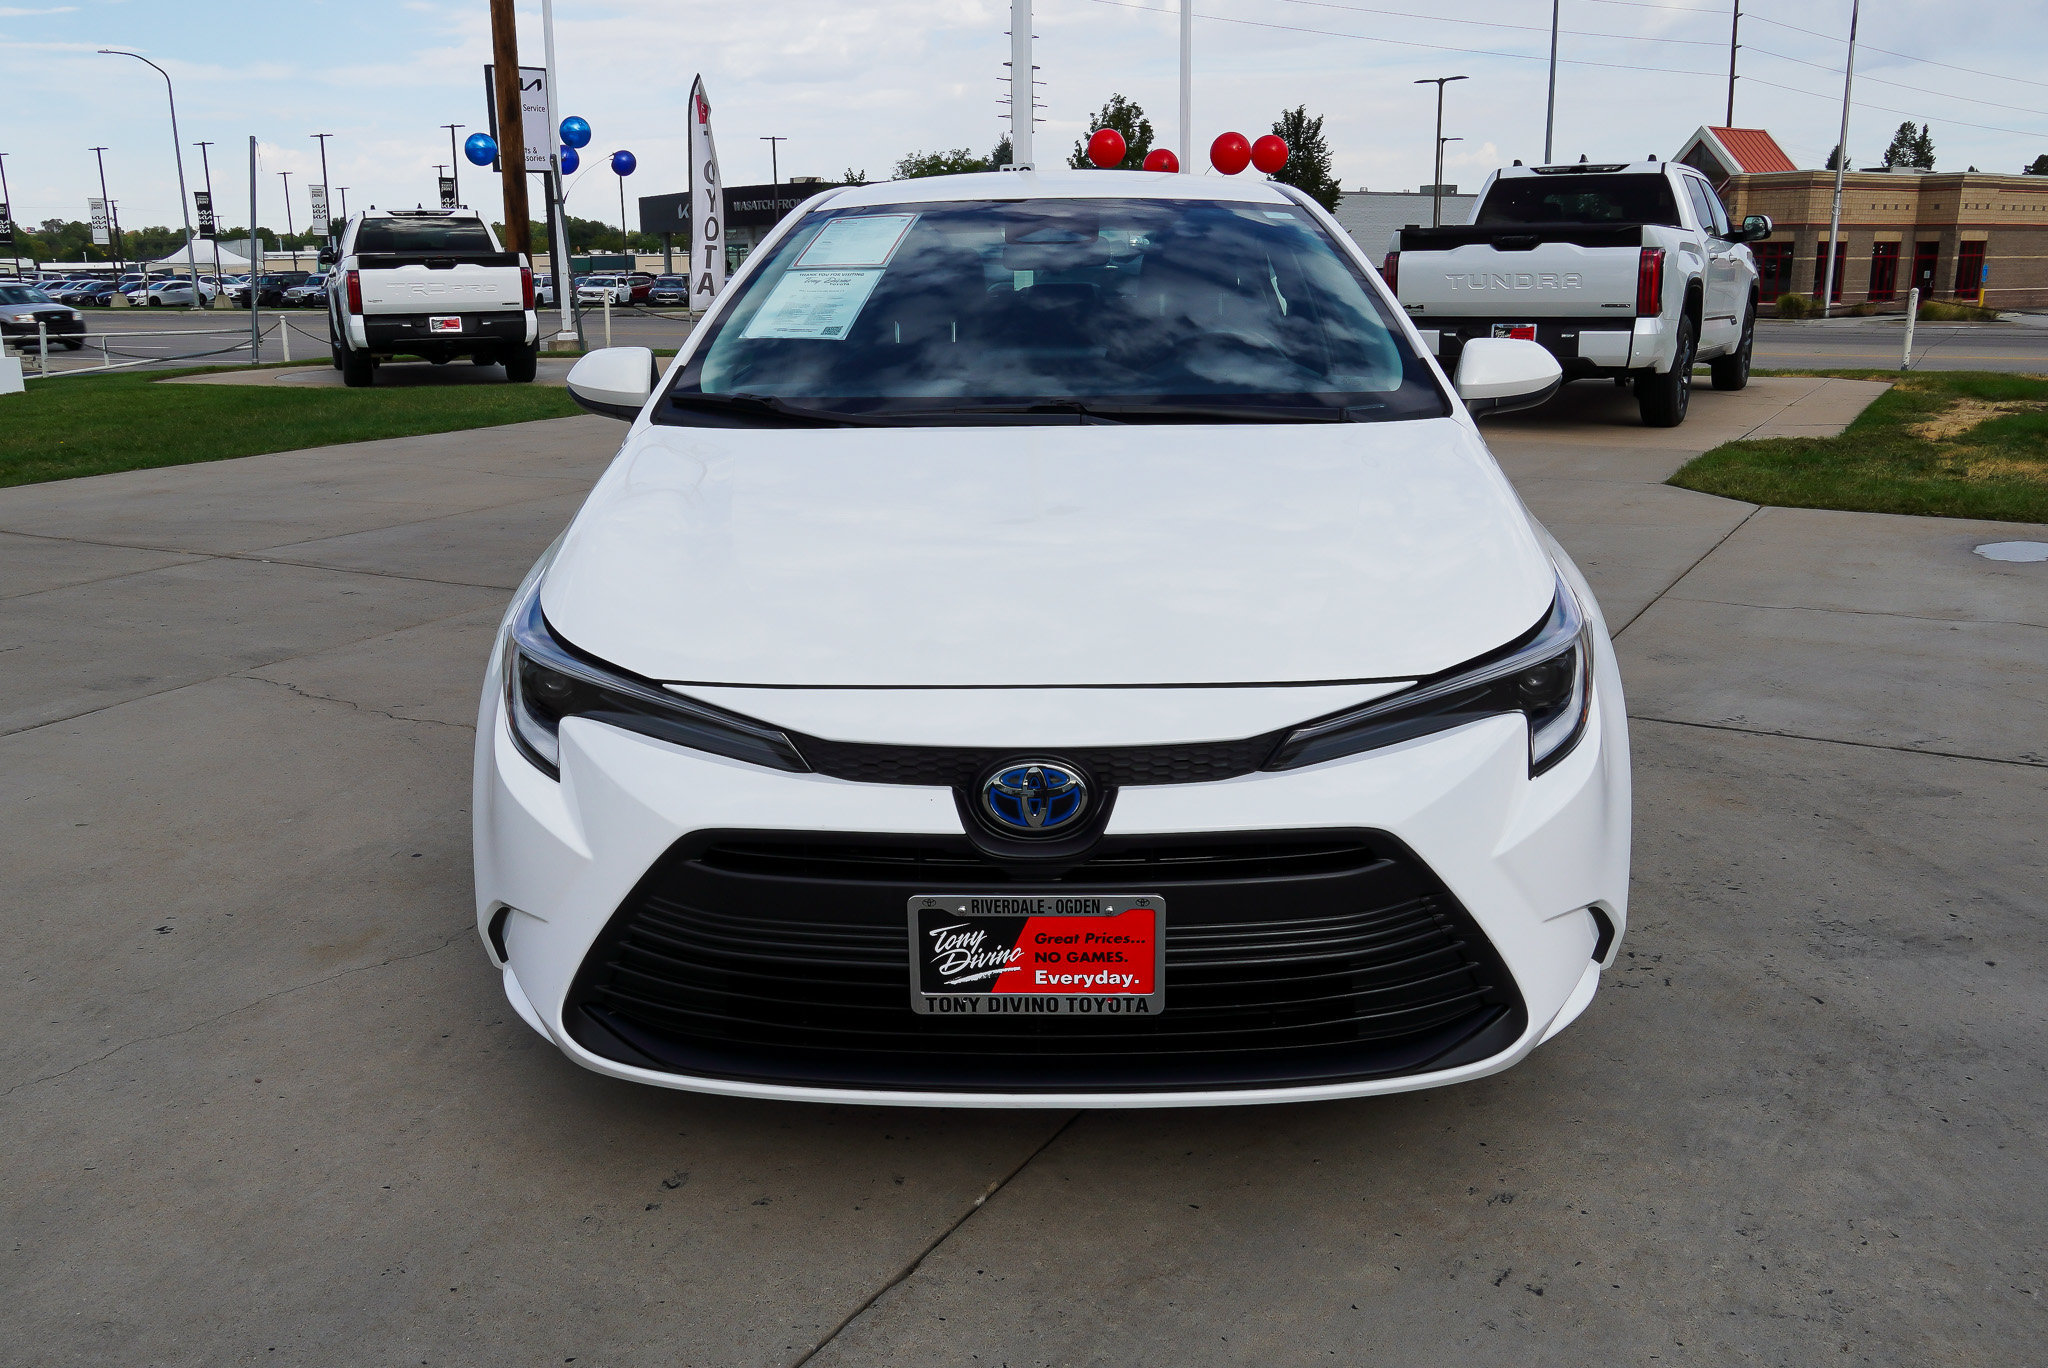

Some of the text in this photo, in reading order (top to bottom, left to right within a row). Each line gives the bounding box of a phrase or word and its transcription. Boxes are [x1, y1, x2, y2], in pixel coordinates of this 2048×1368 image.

[522, 104, 546, 113] Service
[524, 154, 546, 162] sories
[733, 198, 805, 211] WASATCH FRON
[1444, 272, 1584, 290] TUNDRA
[971, 899, 1045, 914] RIVERDALE
[1055, 899, 1101, 914] OGDEN
[929, 922, 988, 955] Tony
[1034, 932, 1146, 944] Great Prices...
[930, 945, 1025, 976] Divino
[1034, 951, 1128, 963] NO GAMES.
[1035, 970, 1140, 988] Everyday.
[925, 996, 1149, 1013] TONY DIVINO TOYOTA
